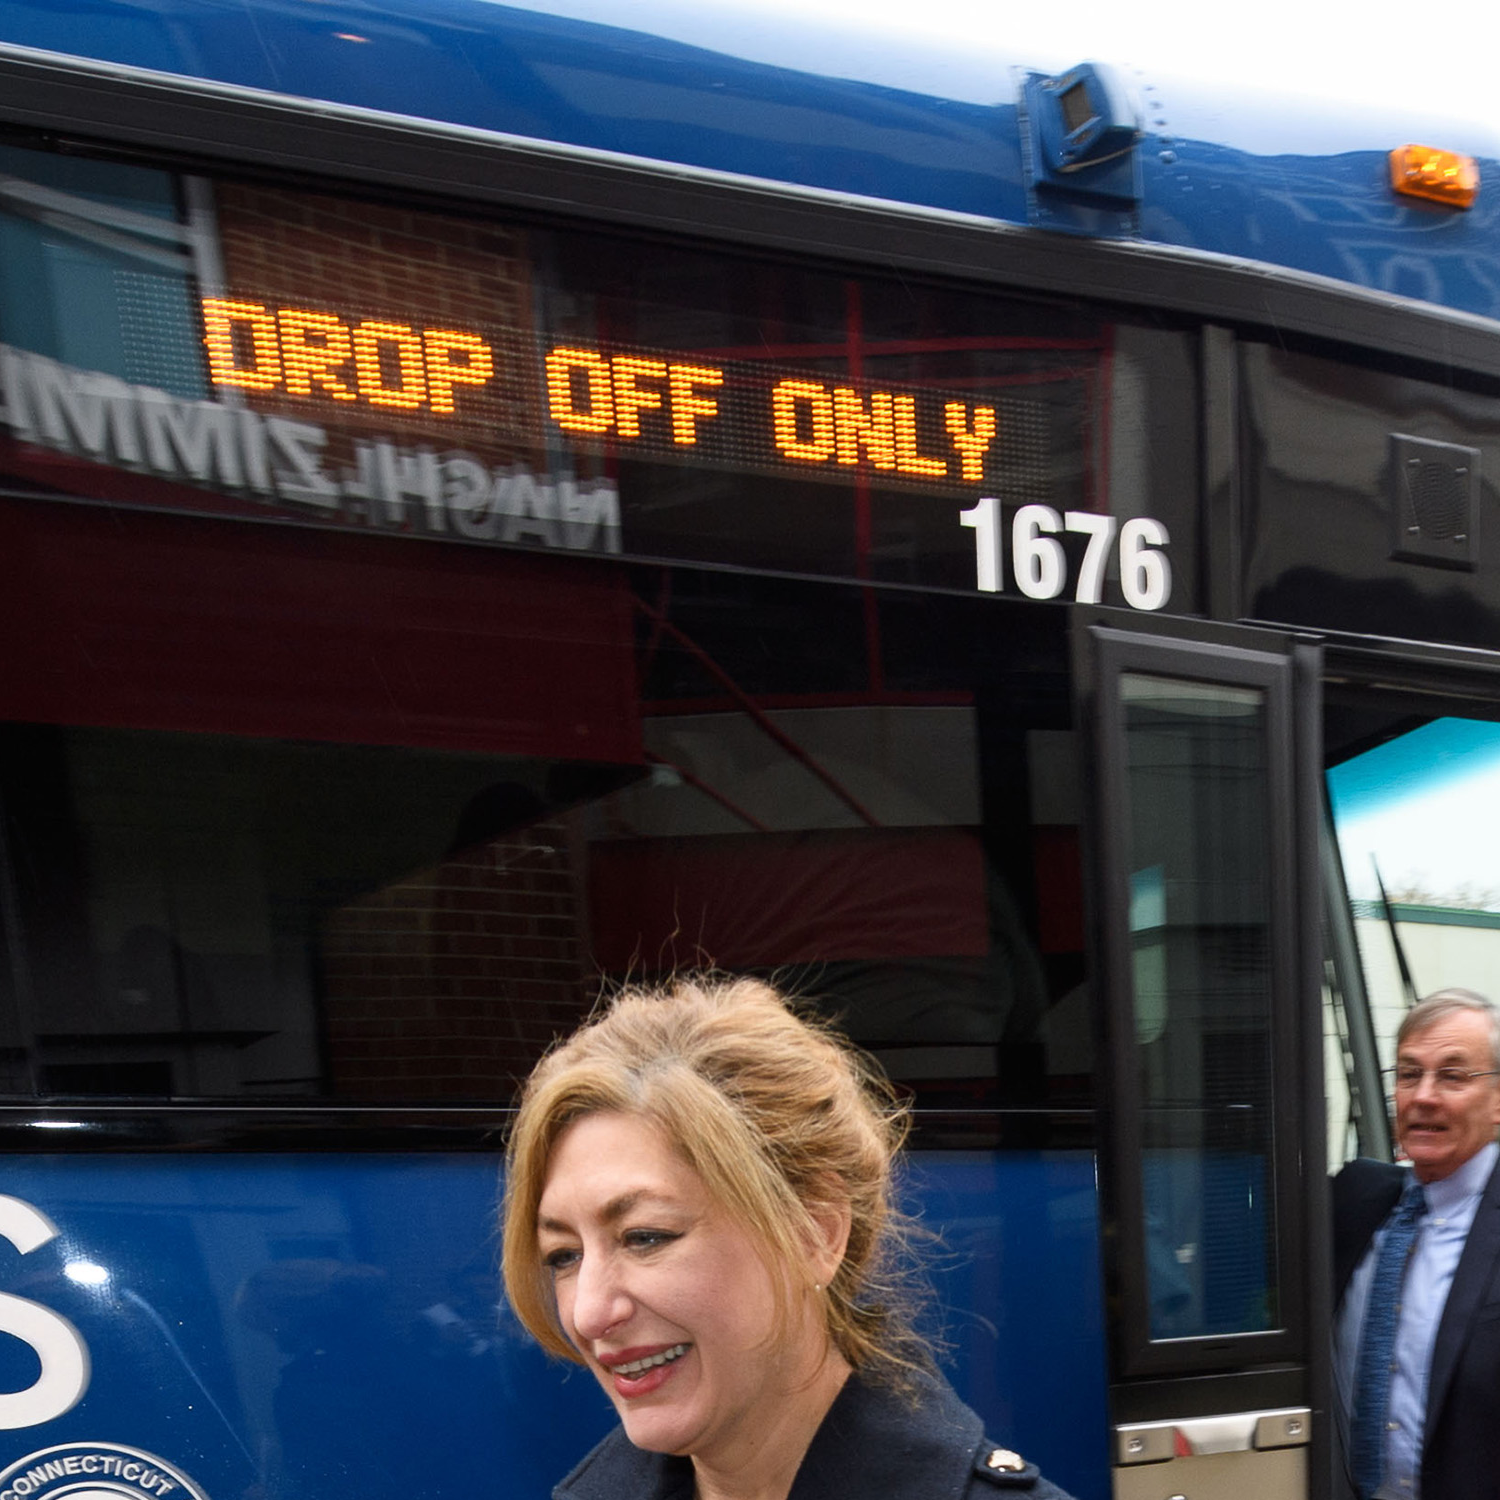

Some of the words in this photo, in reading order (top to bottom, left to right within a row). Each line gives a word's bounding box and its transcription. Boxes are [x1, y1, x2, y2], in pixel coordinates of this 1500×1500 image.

[203, 297, 493, 413] DROP
[545, 345, 723, 445] OFF
[771, 378, 997, 481] ONLY
[959, 498, 1171, 610] 1676
